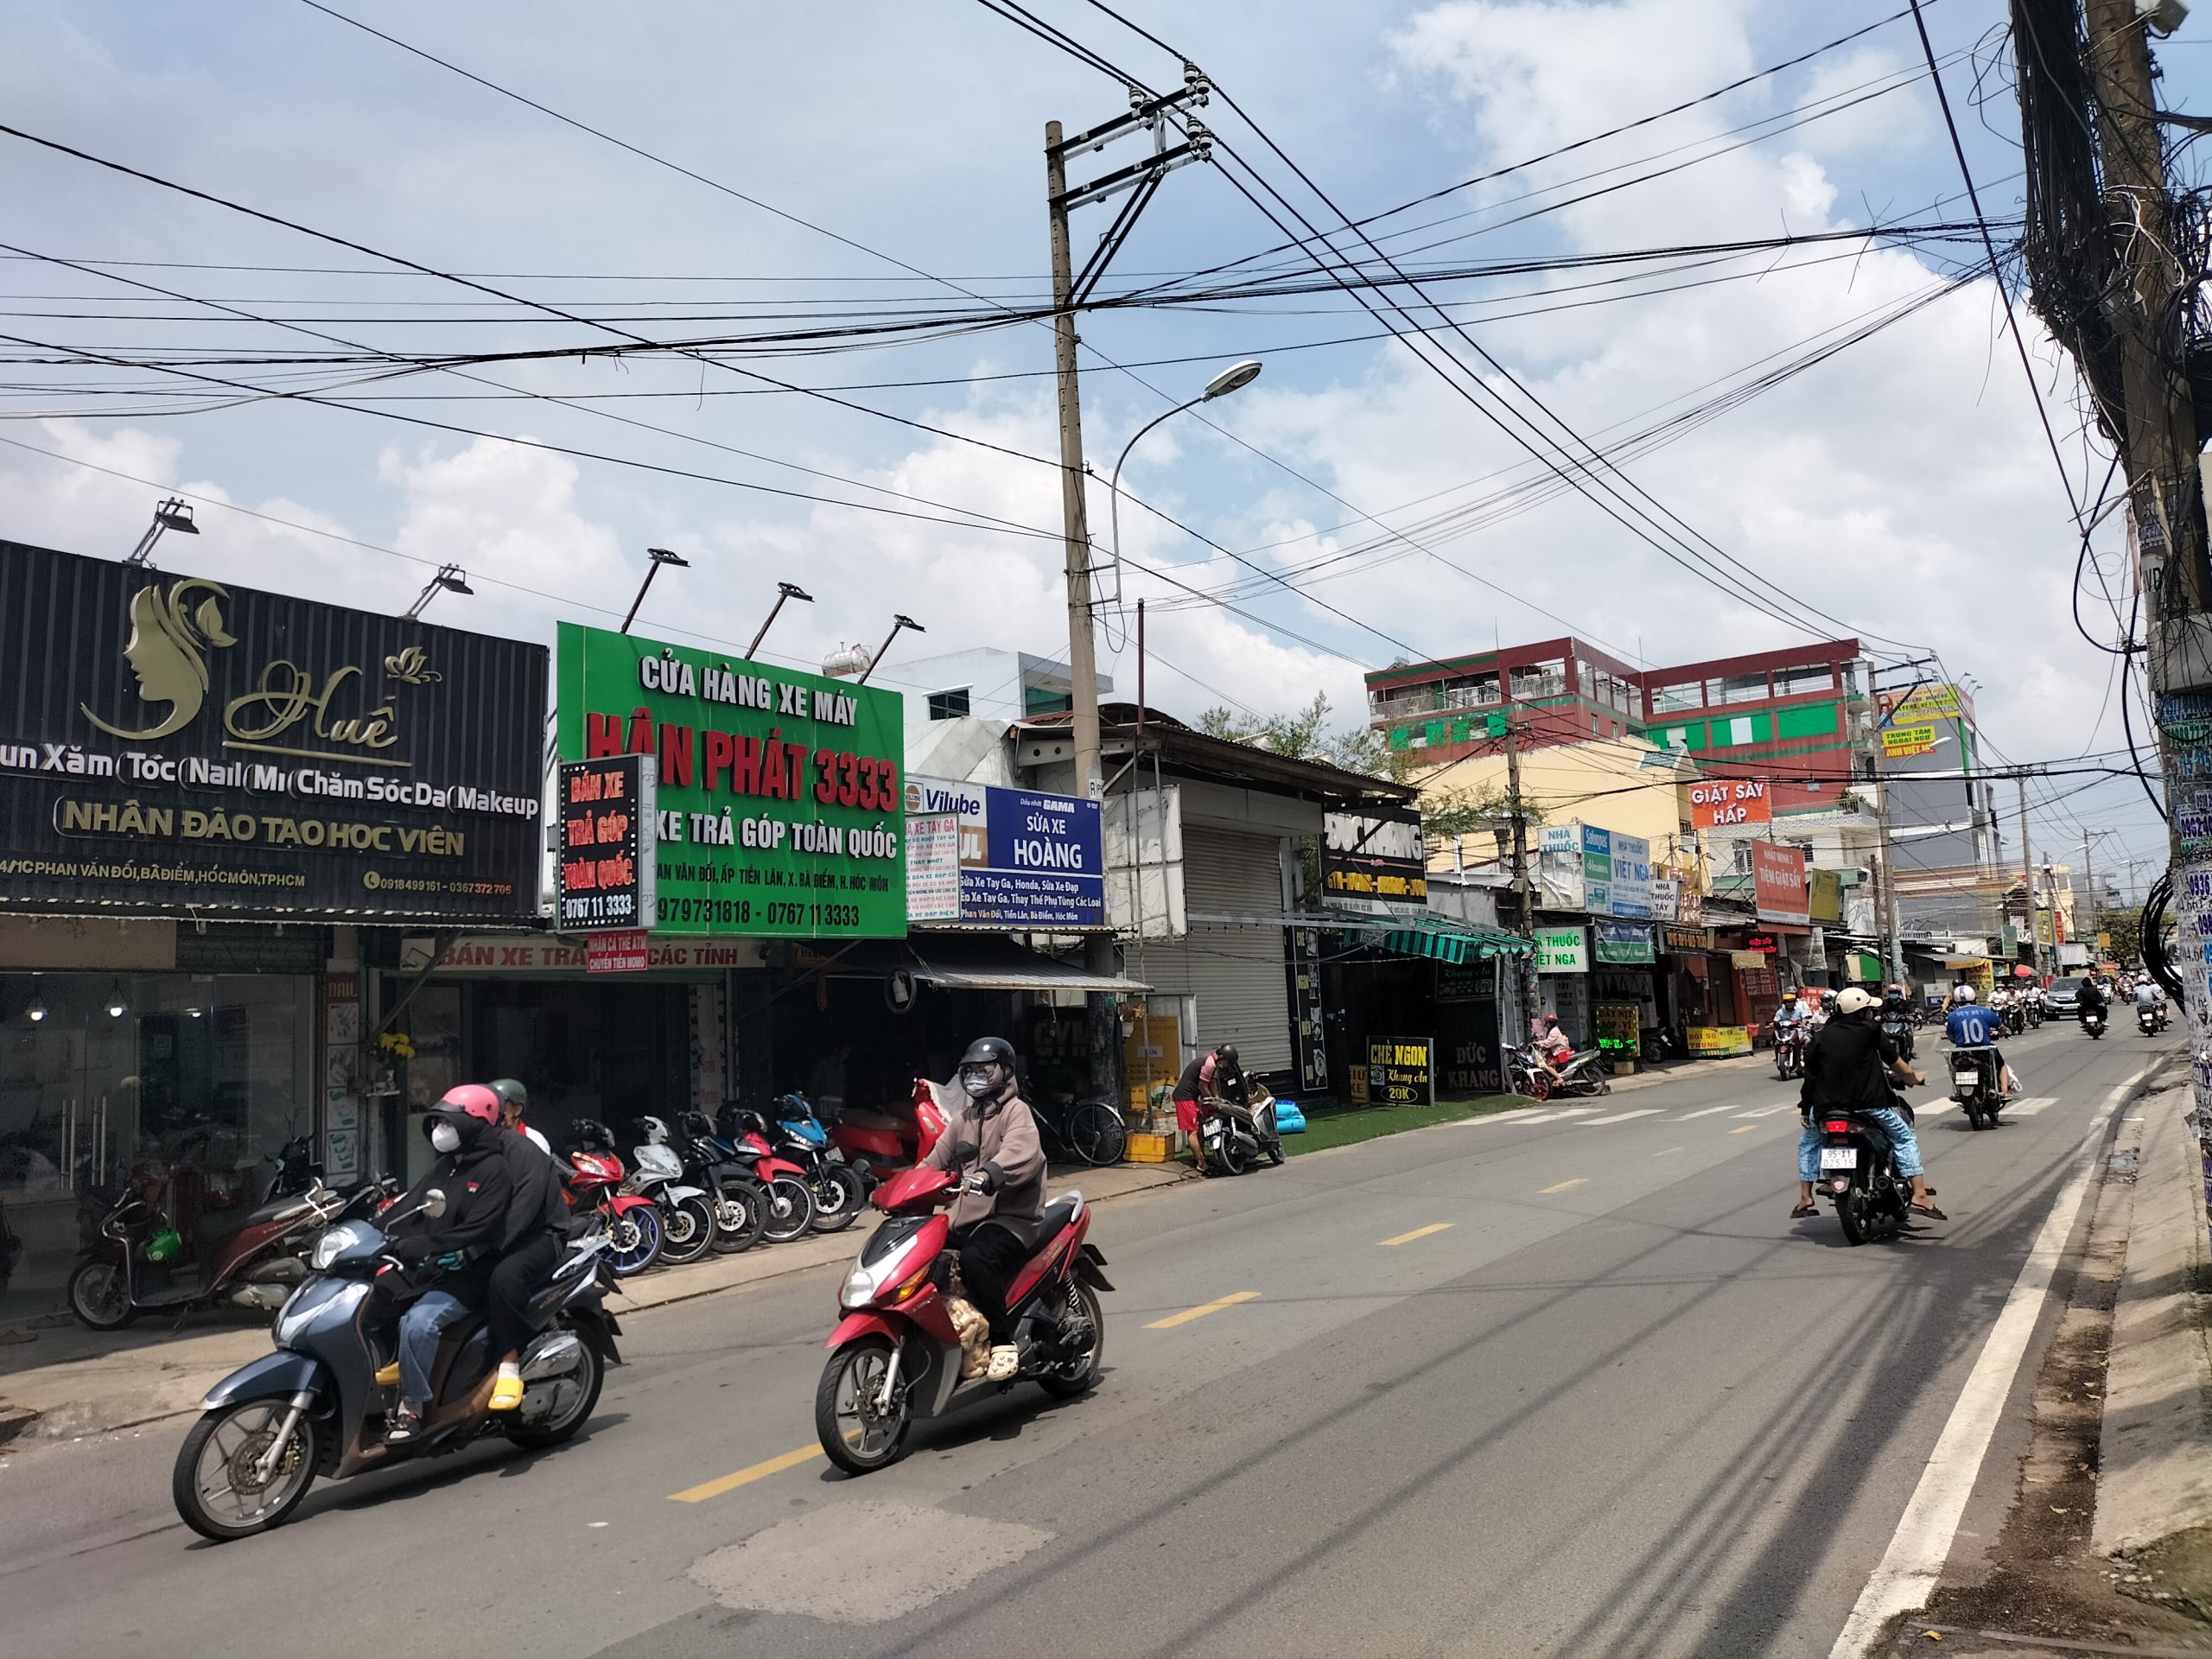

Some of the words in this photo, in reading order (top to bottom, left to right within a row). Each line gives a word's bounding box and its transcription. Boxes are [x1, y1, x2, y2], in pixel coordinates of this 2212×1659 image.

[642, 648, 696, 696] CỬA
[702, 663, 771, 709] HÀNG
[778, 683, 807, 716] XE
[814, 690, 857, 726] MÁY
[41, 743, 113, 778] Xăm
[297, 769, 364, 800] Chăm
[366, 777, 413, 804] Sóc
[415, 782, 446, 809] Da
[458, 786, 539, 820] Makeup
[702, 728, 808, 800] PHÁT
[813, 749, 898, 812] 3333
[570, 770, 601, 803] BÁN
[603, 771, 625, 800] XE
[1692, 785, 1728, 804] GIẶT
[1735, 780, 1764, 799] SẤY
[925, 788, 981, 816] Vilube
[1043, 799, 1075, 814] GAMA
[1713, 803, 1747, 824] HẤP
[567, 810, 594, 847] TRẢ
[596, 810, 629, 844] GÓP
[656, 809, 683, 842] XE
[689, 806, 734, 845] TRẢ
[741, 812, 785, 849] GÓP
[791, 819, 842, 855] TOÀN
[848, 821, 898, 859] QUỐC
[914, 822, 925, 836] XE
[926, 820, 942, 835] TAY
[944, 818, 955, 833] GA
[1027, 812, 1050, 832] SỬA
[1052, 817, 1066, 835] XE
[1548, 830, 1571, 840] NHÀ
[397, 824, 465, 856] VIÊN
[1014, 836, 1083, 868] HOÀNG
[1541, 838, 1580, 853] THUỐC
[35, 861, 77, 876] PHAN
[563, 856, 596, 890] TOÀN
[597, 849, 633, 891] QUỐC
[675, 861, 695, 881] VĂN
[975, 876, 985, 887] Xe
[986, 877, 1001, 890] Tay
[1055, 881, 1065, 892] Xe
[1650, 891, 1675, 901] THUỐC
[566, 897, 589, 919] 0767
[591, 896, 603, 918] 11
[606, 894, 632, 916] 3333
[971, 891, 982, 903] Xe
[982, 892, 996, 906] Tay
[1010, 893, 1029, 907] Thay
[657, 896, 751, 924] 979731818
[767, 901, 805, 926] 0767
[824, 905, 860, 927] 3333
[1545, 931, 1580, 947] THUỐC
[499, 947, 533, 966] XE
[647, 944, 689, 967] CÁC
[693, 941, 738, 966] TỈNH
[1535, 951, 1552, 969] IỆT
[1555, 953, 1576, 965] NGA
[1961, 1018, 1984, 1045] 10
[1370, 1039, 1393, 1065] CHÈ
[1395, 1045, 1427, 1066] NGON
[1388, 1087, 1410, 1101] 20K
